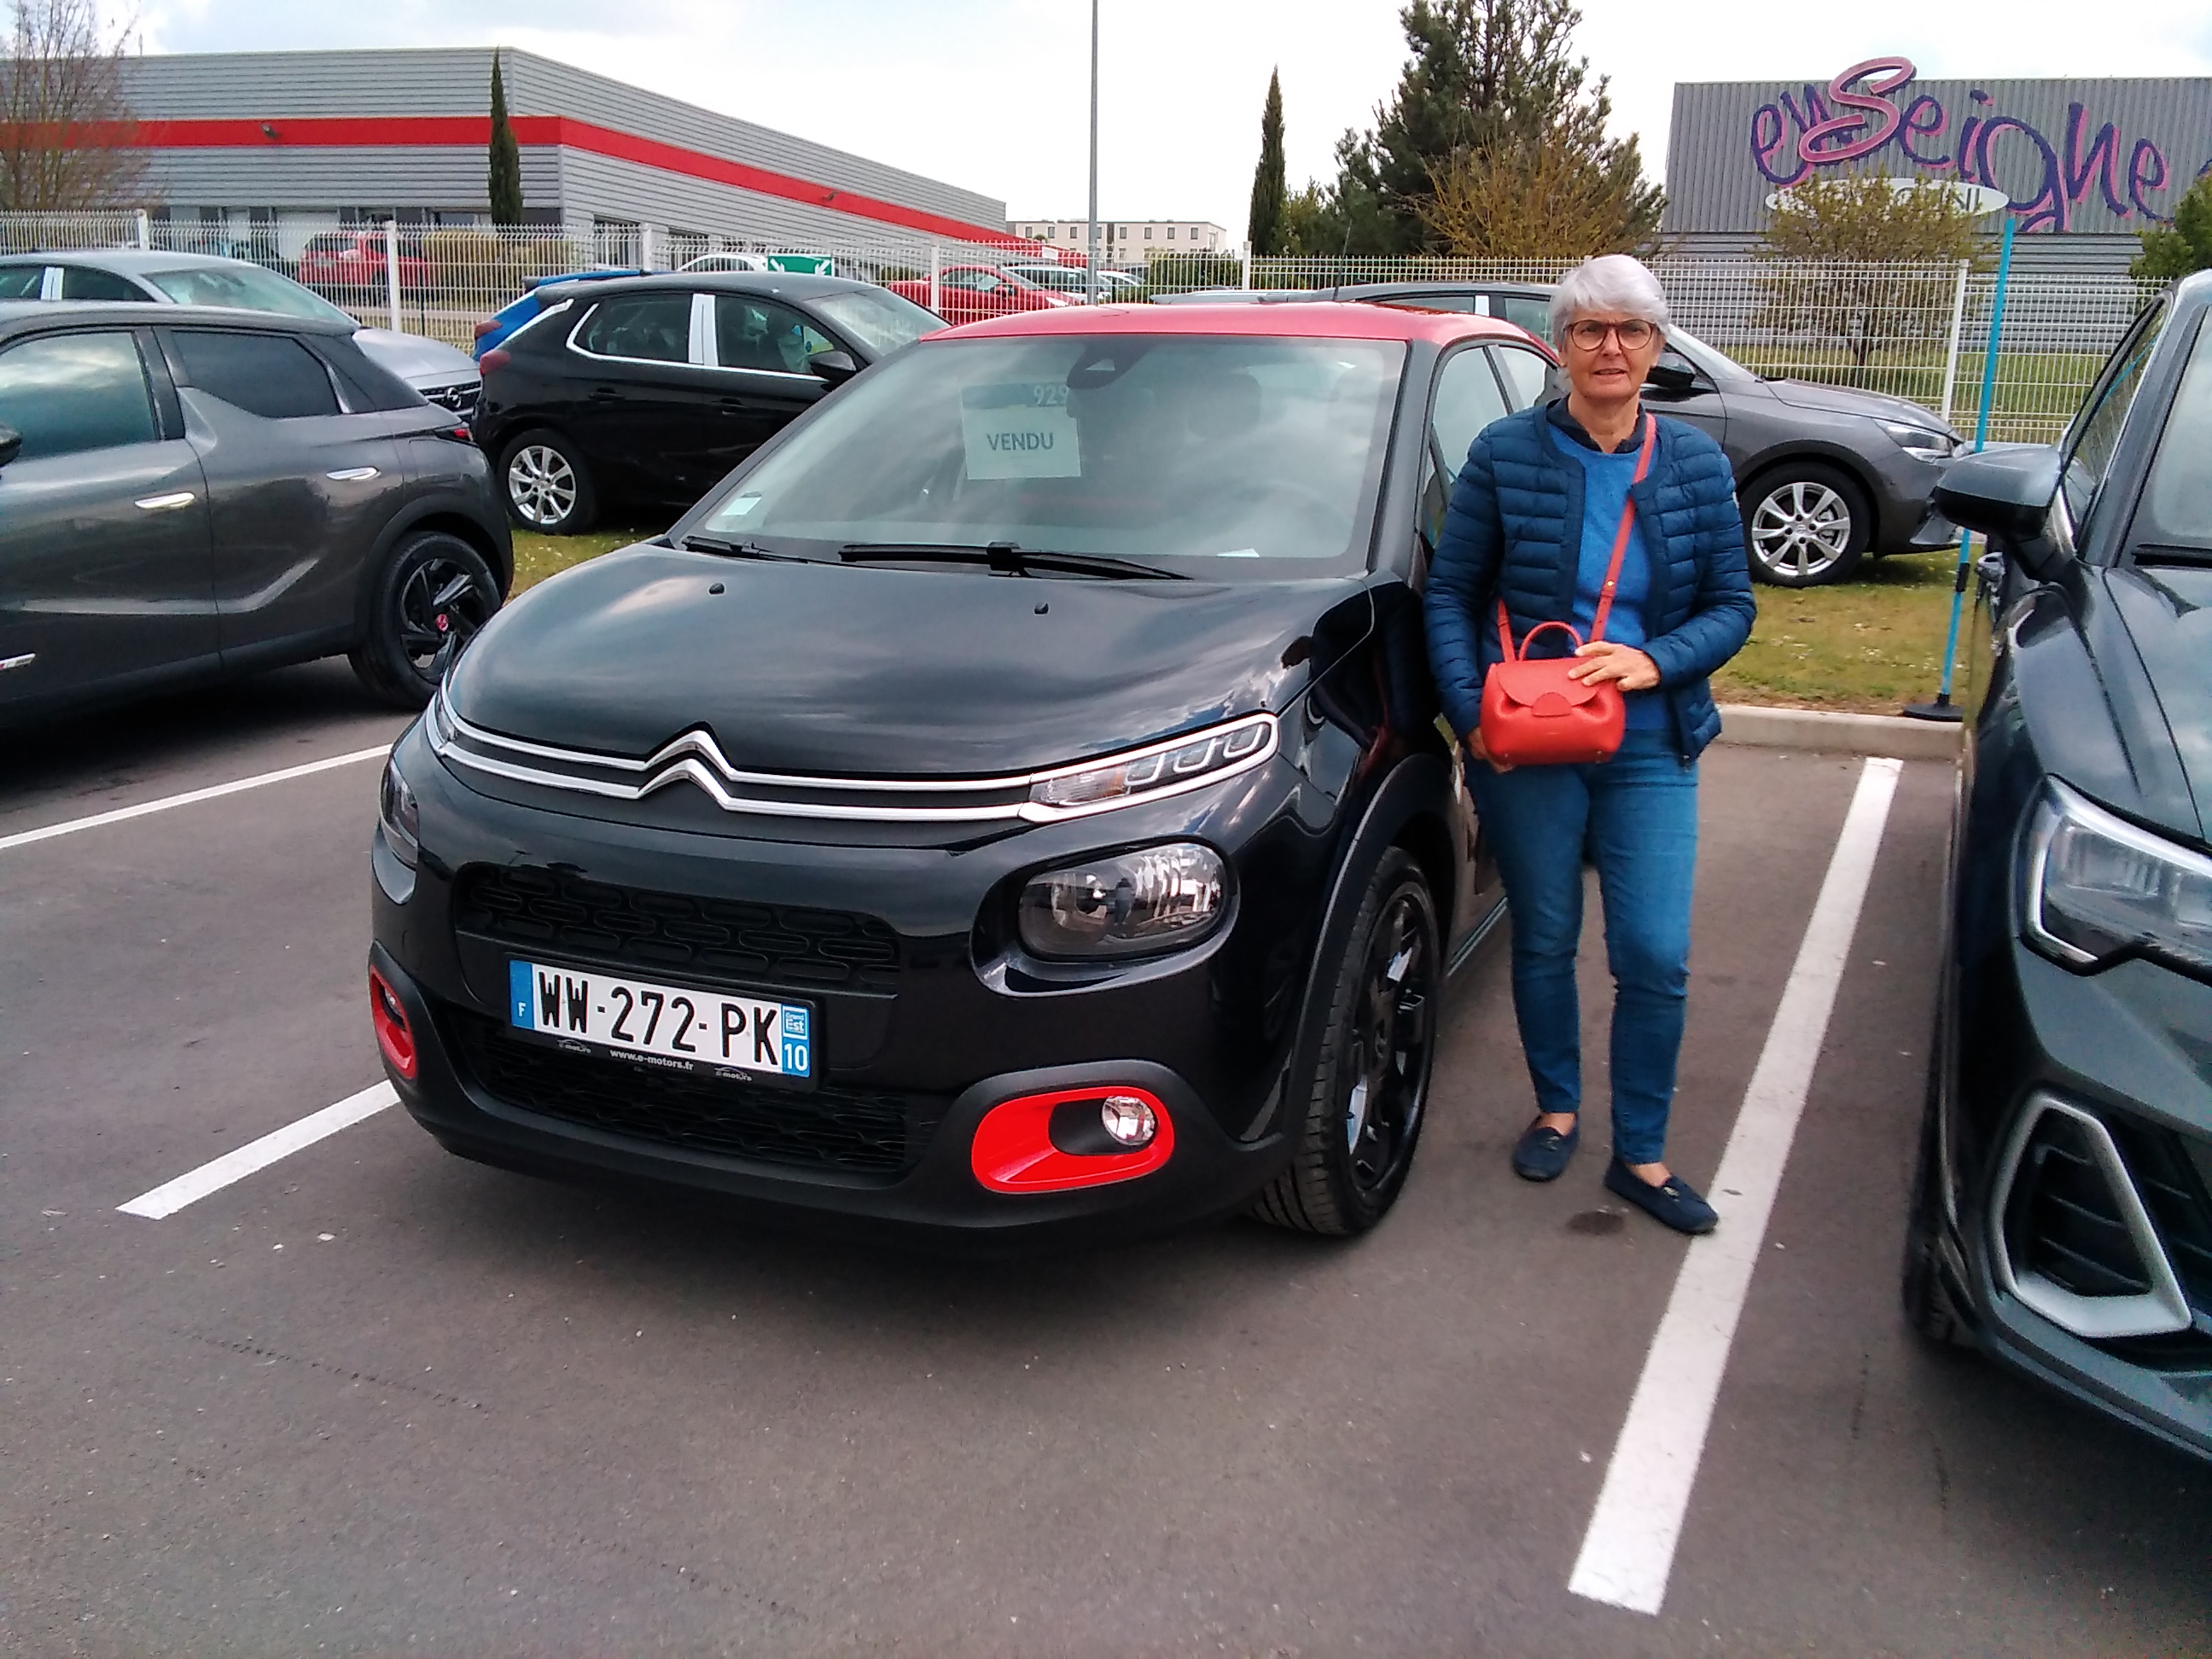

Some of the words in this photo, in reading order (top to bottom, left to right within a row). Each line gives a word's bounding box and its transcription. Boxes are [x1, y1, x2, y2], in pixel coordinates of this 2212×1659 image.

[987, 432, 1054, 451] VENDU
[518, 1001, 527, 1017] F
[785, 1011, 805, 1022] Grand
[785, 1020, 805, 1032] Est
[609, 1049, 695, 1071] www.e-motors.fr
[783, 1043, 808, 1072] 10
